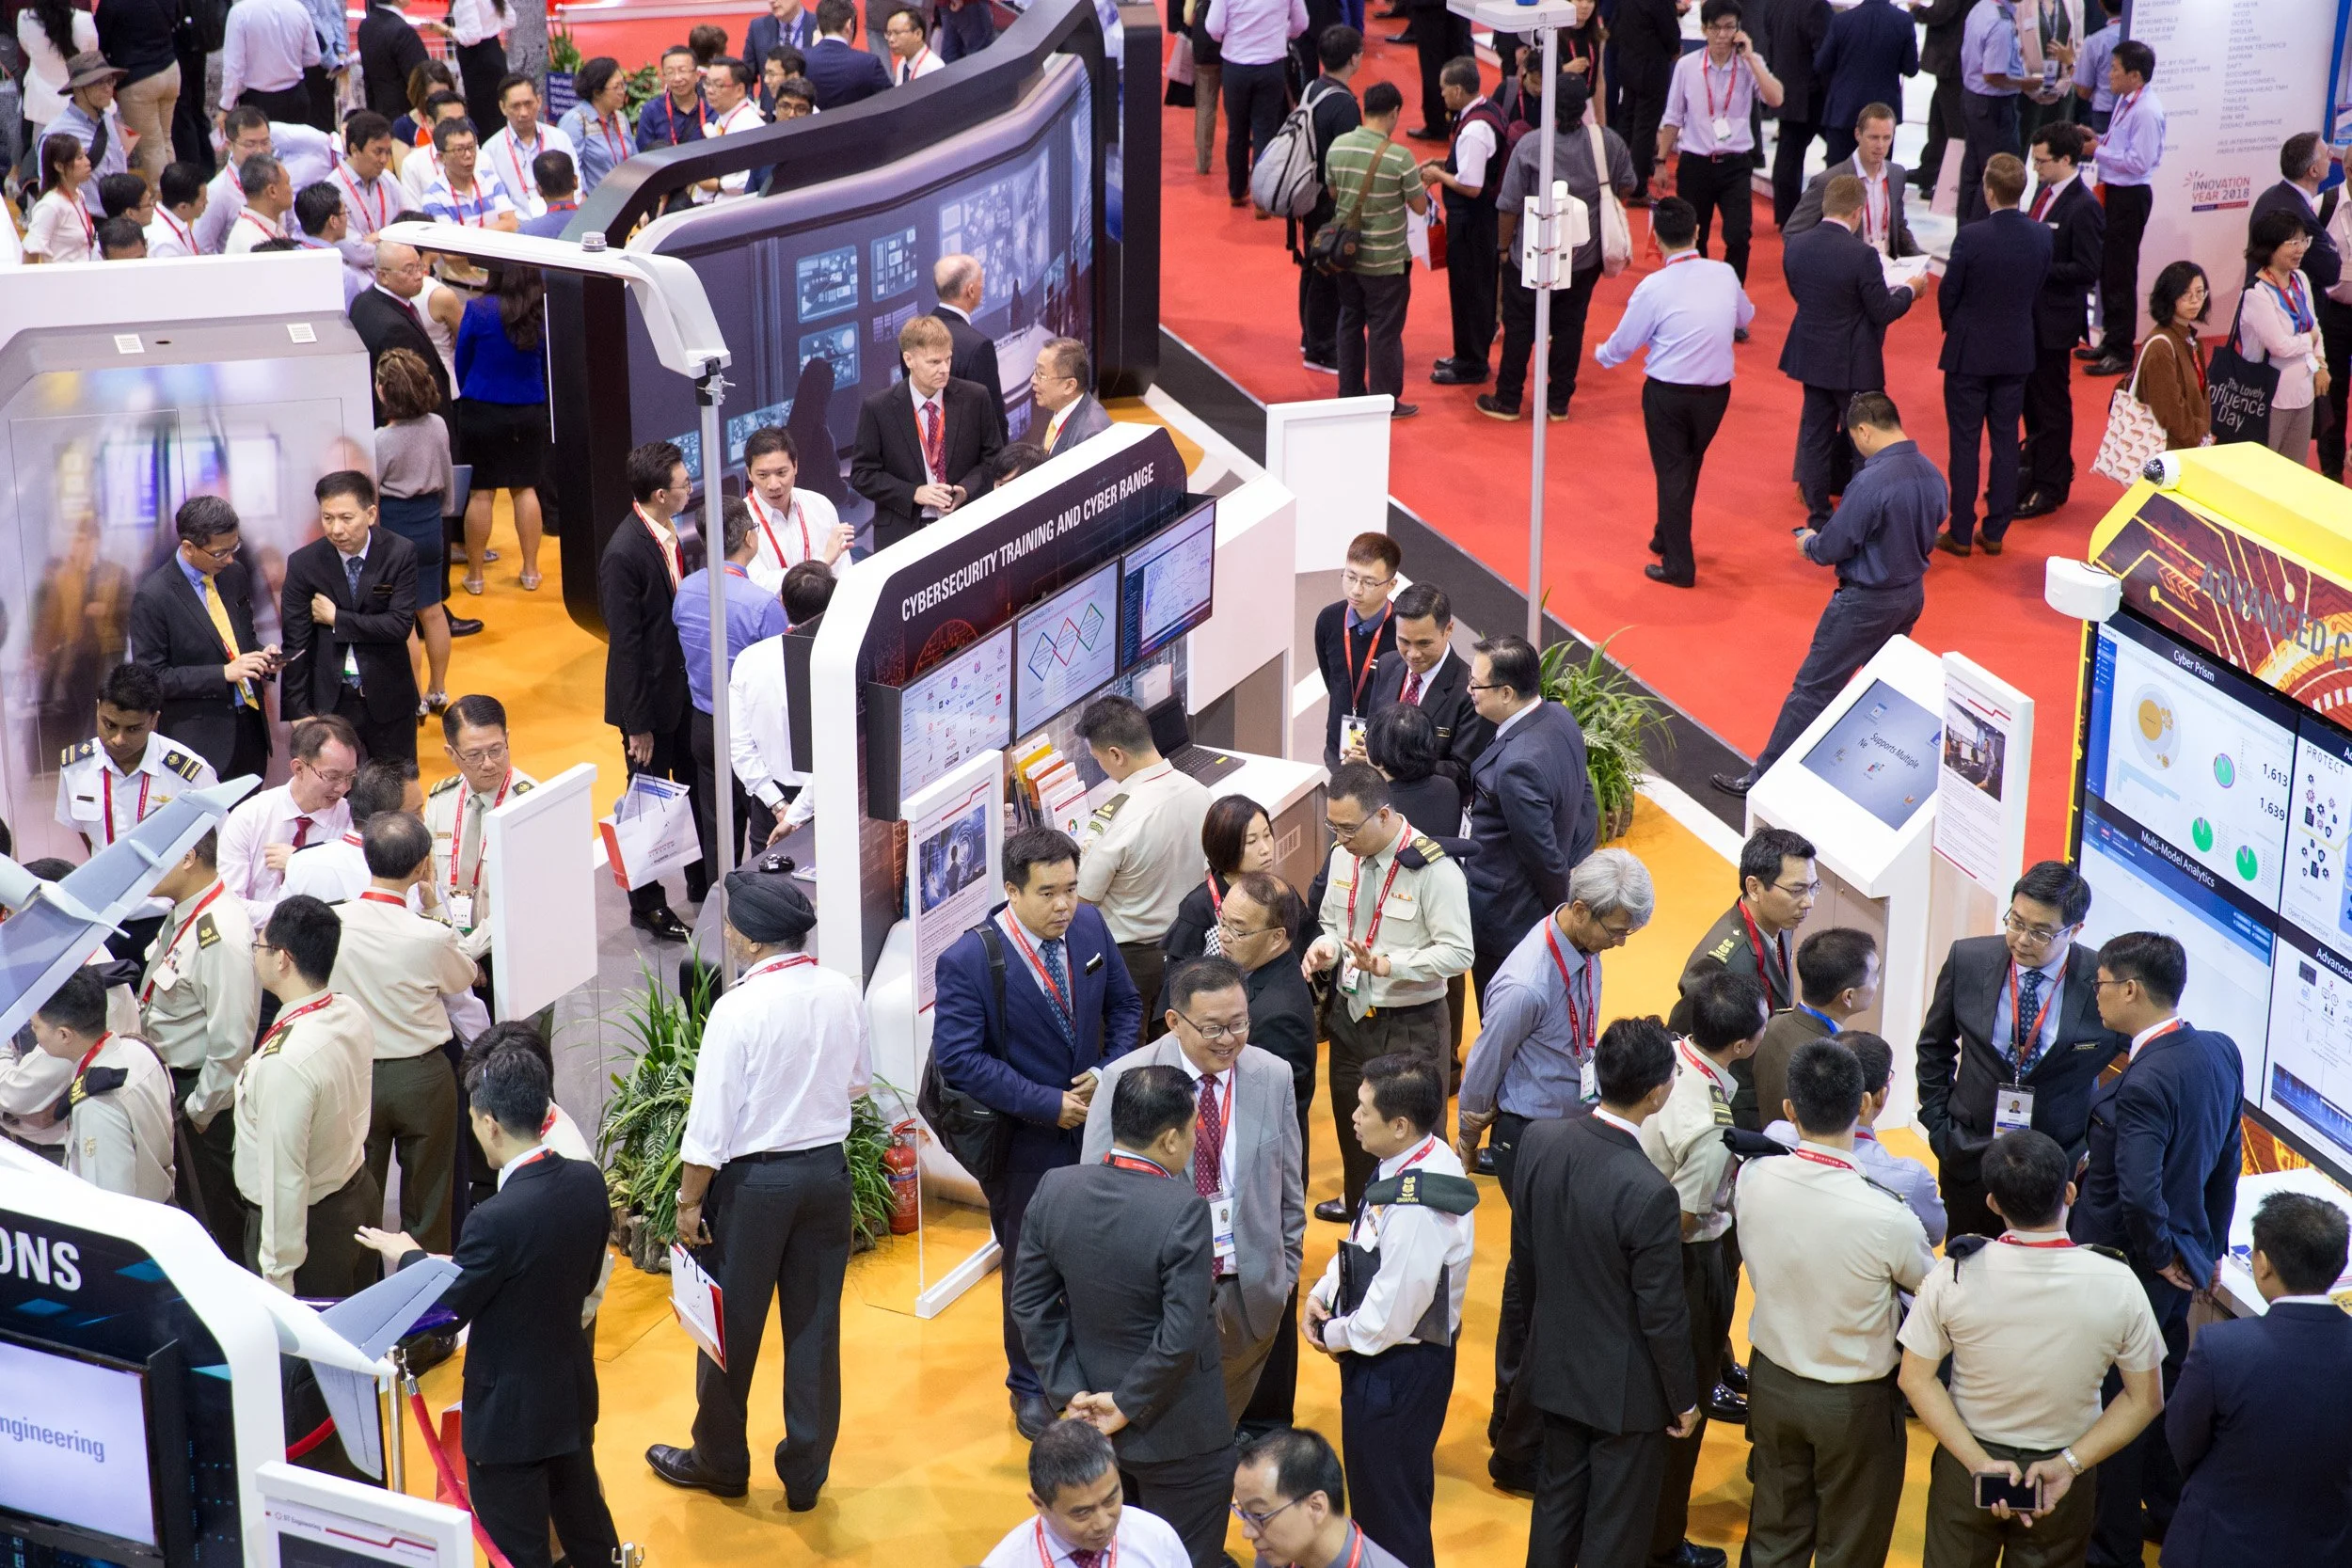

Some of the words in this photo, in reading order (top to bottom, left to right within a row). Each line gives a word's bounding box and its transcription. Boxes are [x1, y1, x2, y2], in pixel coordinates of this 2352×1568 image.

[2192, 177, 2250, 191] INNOVATION
[2192, 191, 2218, 202] YEAR
[2222, 188, 2249, 200] 2018
[2207, 383, 2265, 418] nfluence
[2228, 377, 2239, 390] The
[2240, 384, 2265, 402] Lovely
[2217, 404, 2246, 433] Day
[901, 549, 998, 623] CYBERSECURITY
[999, 519, 1054, 567] TRAINING
[1057, 504, 1080, 536] AND
[1084, 483, 1118, 521] CYBER
[1120, 462, 1153, 500] RANGE
[2200, 561, 2327, 657] ADVANCED
[2173, 650, 2194, 670] Cyber
[2194, 662, 2215, 683] Prism
[1857, 737, 1868, 749] Ne
[1870, 733, 1897, 754] Supports
[1895, 749, 1919, 769] Multiple
[2307, 745, 2344, 775] PROTECT
[2263, 764, 2288, 787] 1,613
[2260, 798, 2285, 821] 1,639
[2141, 830, 2183, 865] Multi-Model
[2183, 858, 2216, 888] Analytics
[0, 1417, 104, 1463] ngineering
